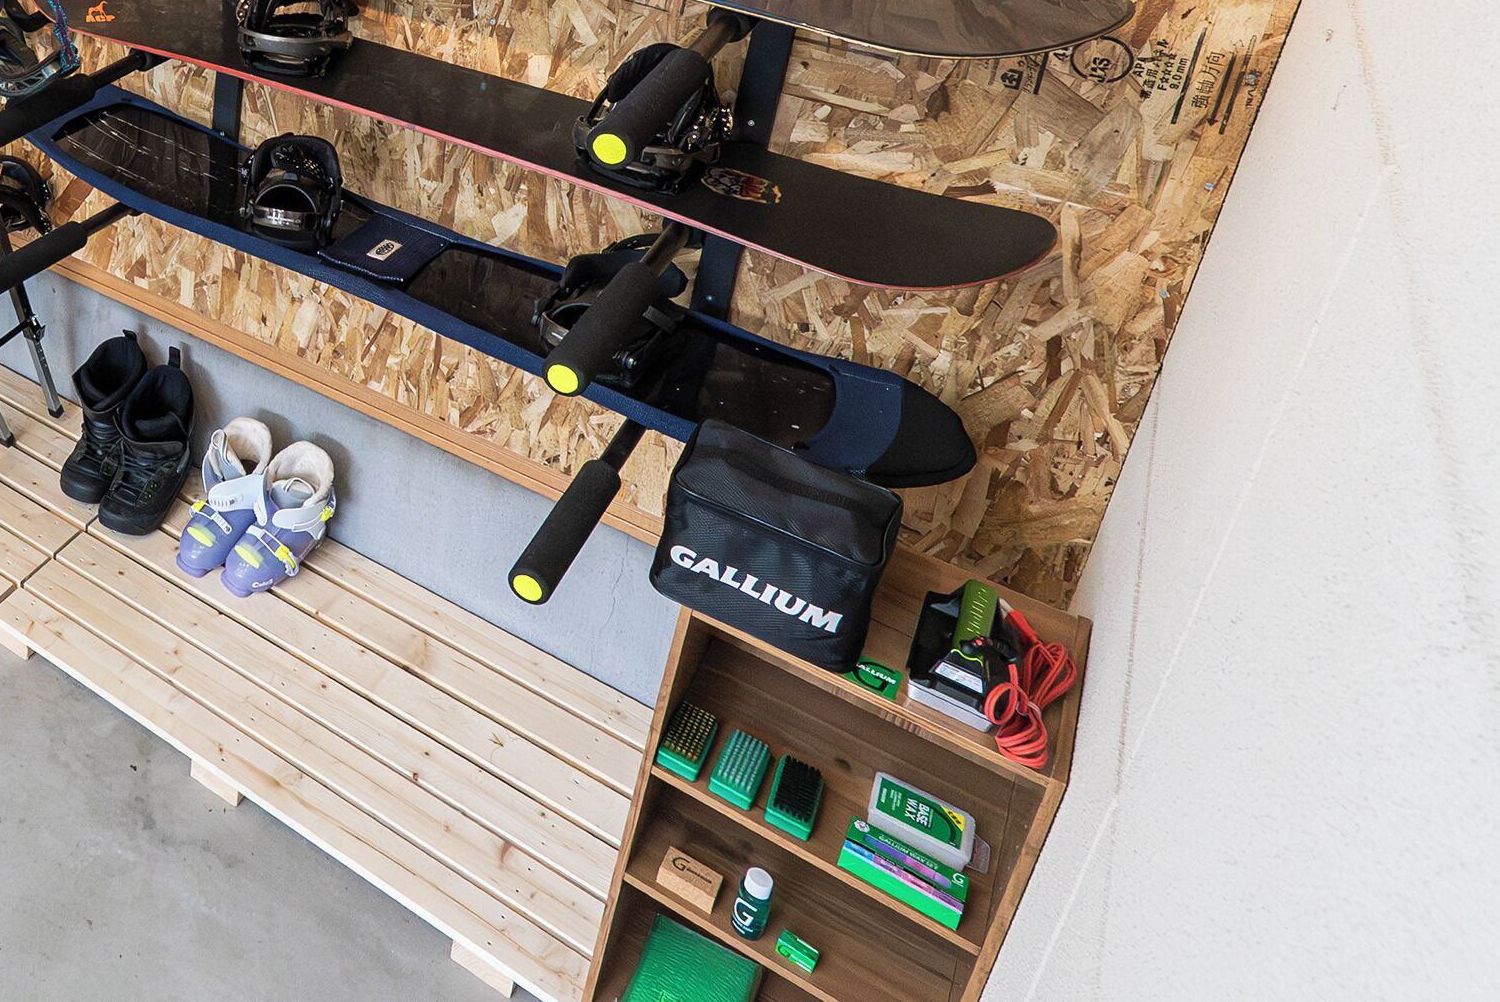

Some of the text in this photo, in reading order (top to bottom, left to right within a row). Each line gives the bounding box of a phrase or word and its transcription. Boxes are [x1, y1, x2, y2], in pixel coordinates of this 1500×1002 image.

[670, 545, 844, 633] GALLIUM
[904, 797, 918, 822] WAX
[916, 802, 930, 828] BASE
[878, 834, 910, 854] GALLIUM
